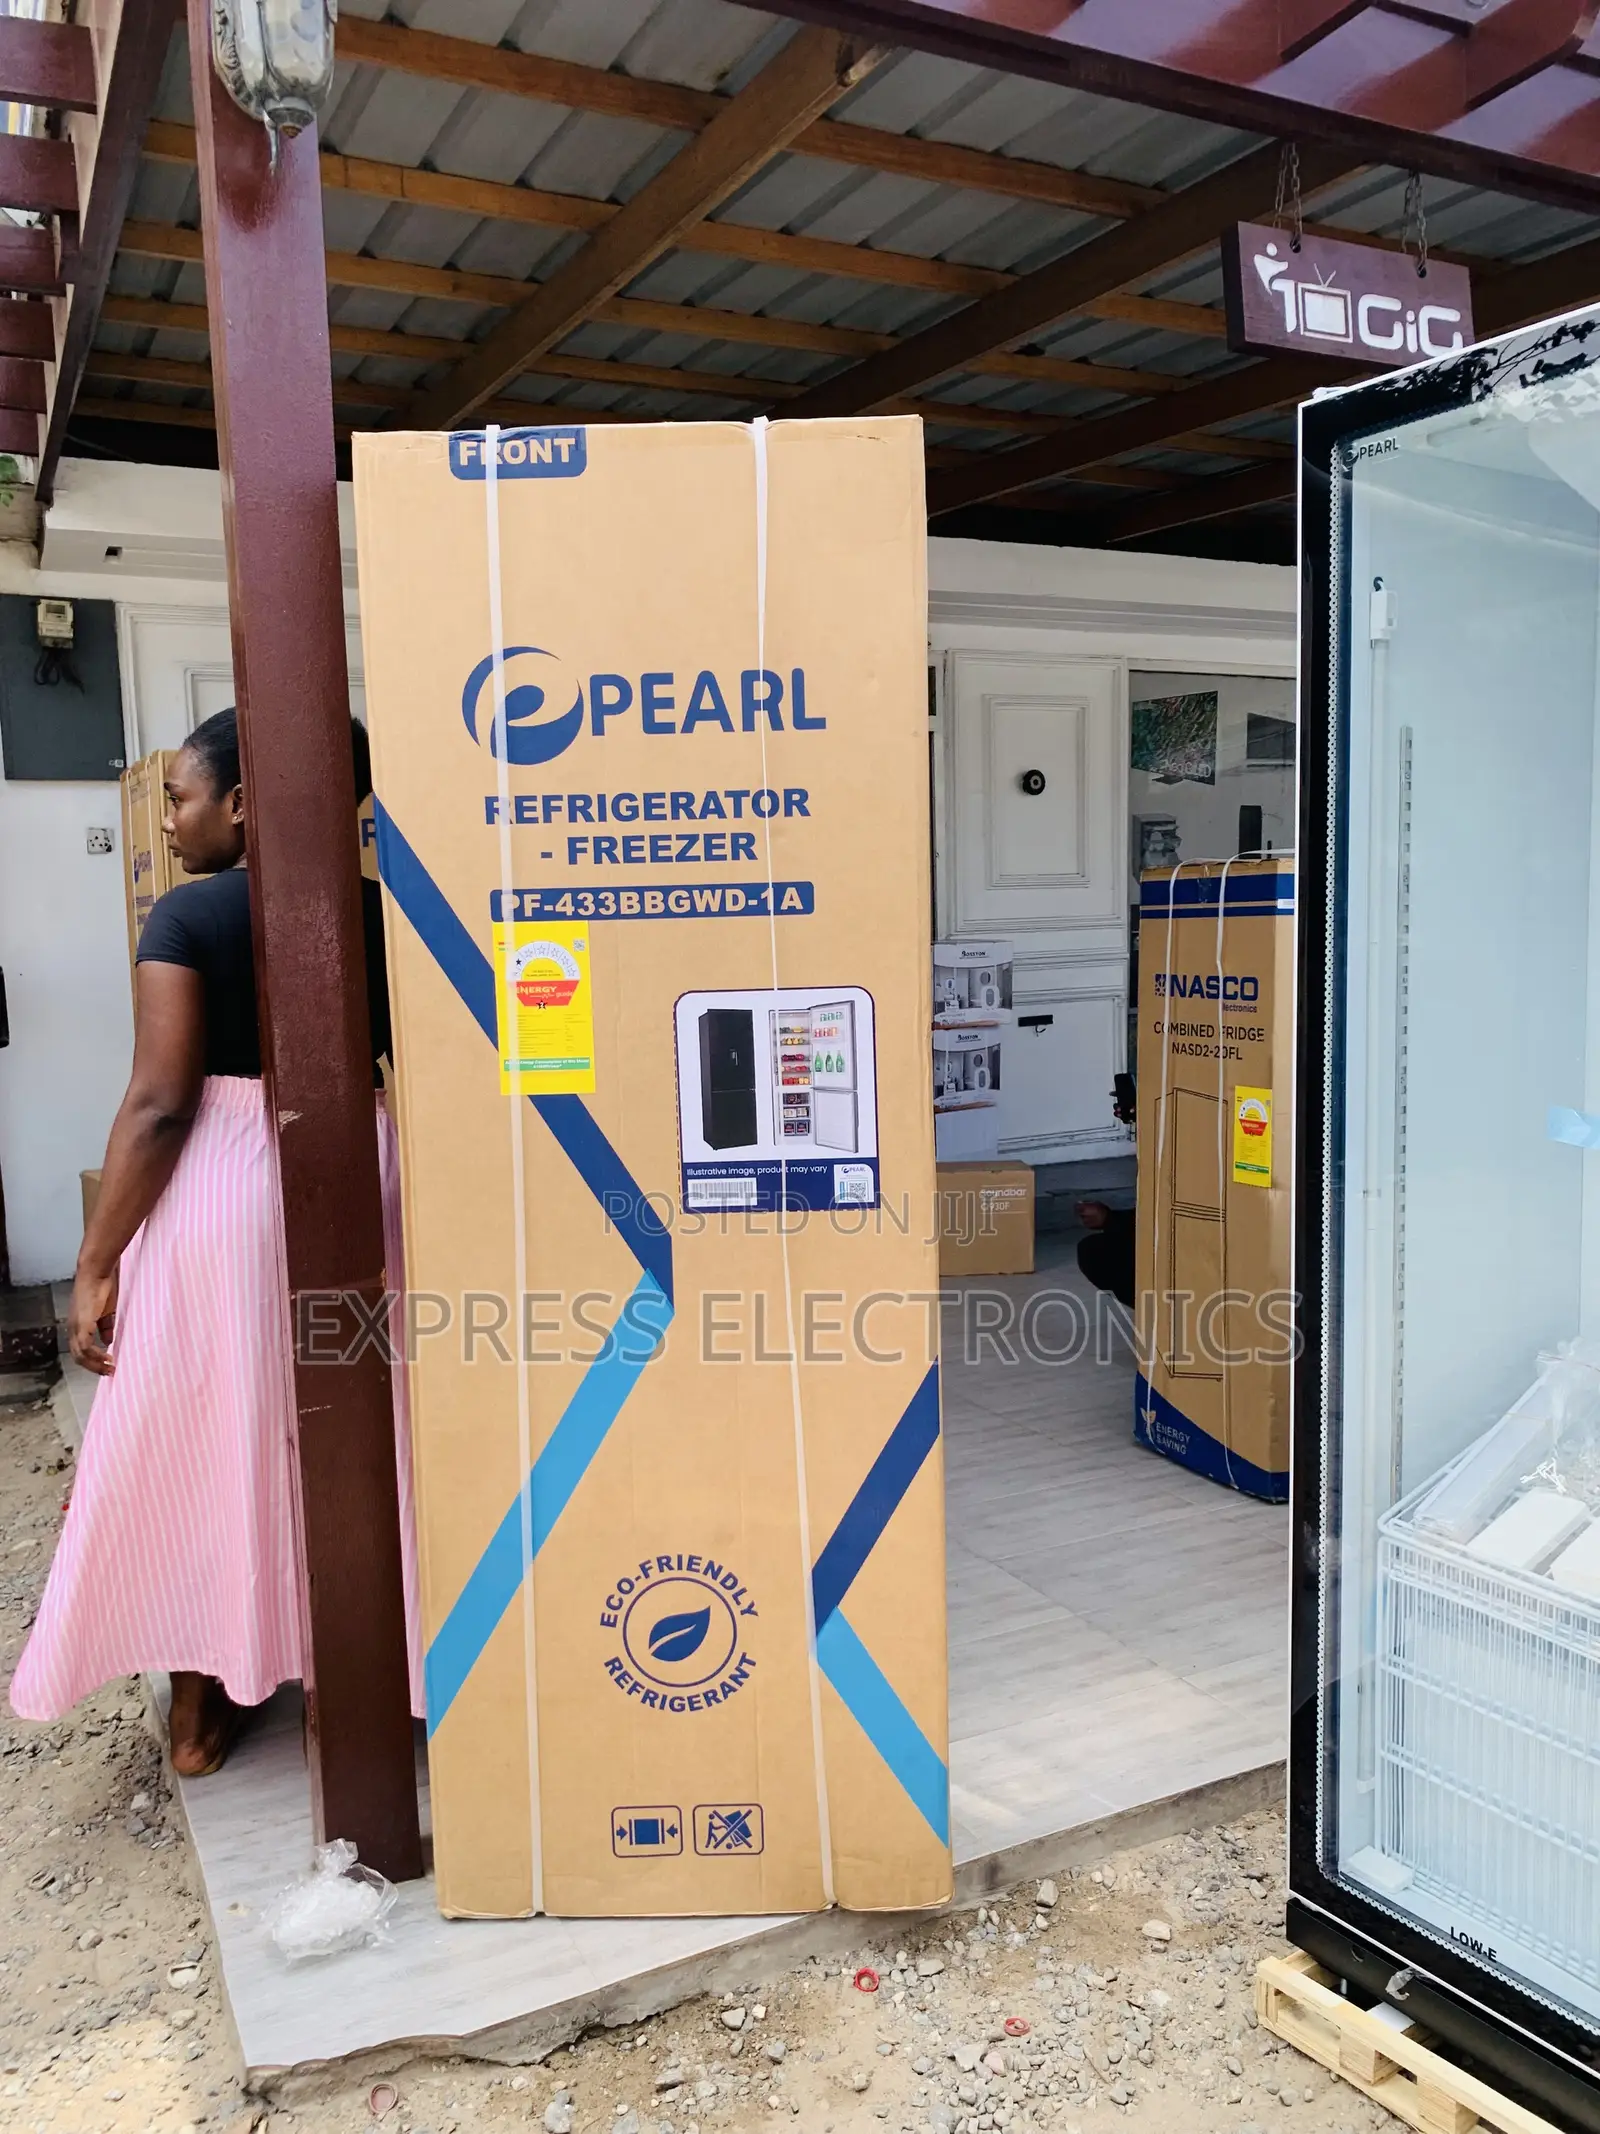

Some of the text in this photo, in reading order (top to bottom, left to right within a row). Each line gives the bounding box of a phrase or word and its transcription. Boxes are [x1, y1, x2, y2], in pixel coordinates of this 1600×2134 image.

[460, 438, 576, 466] FRONT
[1360, 438, 1399, 460] PEARL
[589, 668, 827, 737] PEARL
[484, 788, 812, 825] REFRIGERATOR
[567, 832, 758, 865] FREEZER
[501, 886, 804, 917] PF-433BBGWD-1A
[1169, 974, 1259, 1002] NASCO
[1222, 1001, 1258, 1014] lectronics
[1153, 1021, 1215, 1039] COMBINED
[1171, 1041, 1243, 1061] NASD2-20FL
[686, 1165, 828, 1176] Illustrative image, produt may vary
[1155, 1421, 1191, 1443] ENERGY
[1156, 1433, 1187, 1455] SAVING
[599, 1554, 759, 1628] ECO-FRIENDLY
[603, 1651, 757, 1713] REFRIGERANT
[1450, 1926, 1498, 1963] LOW-E
